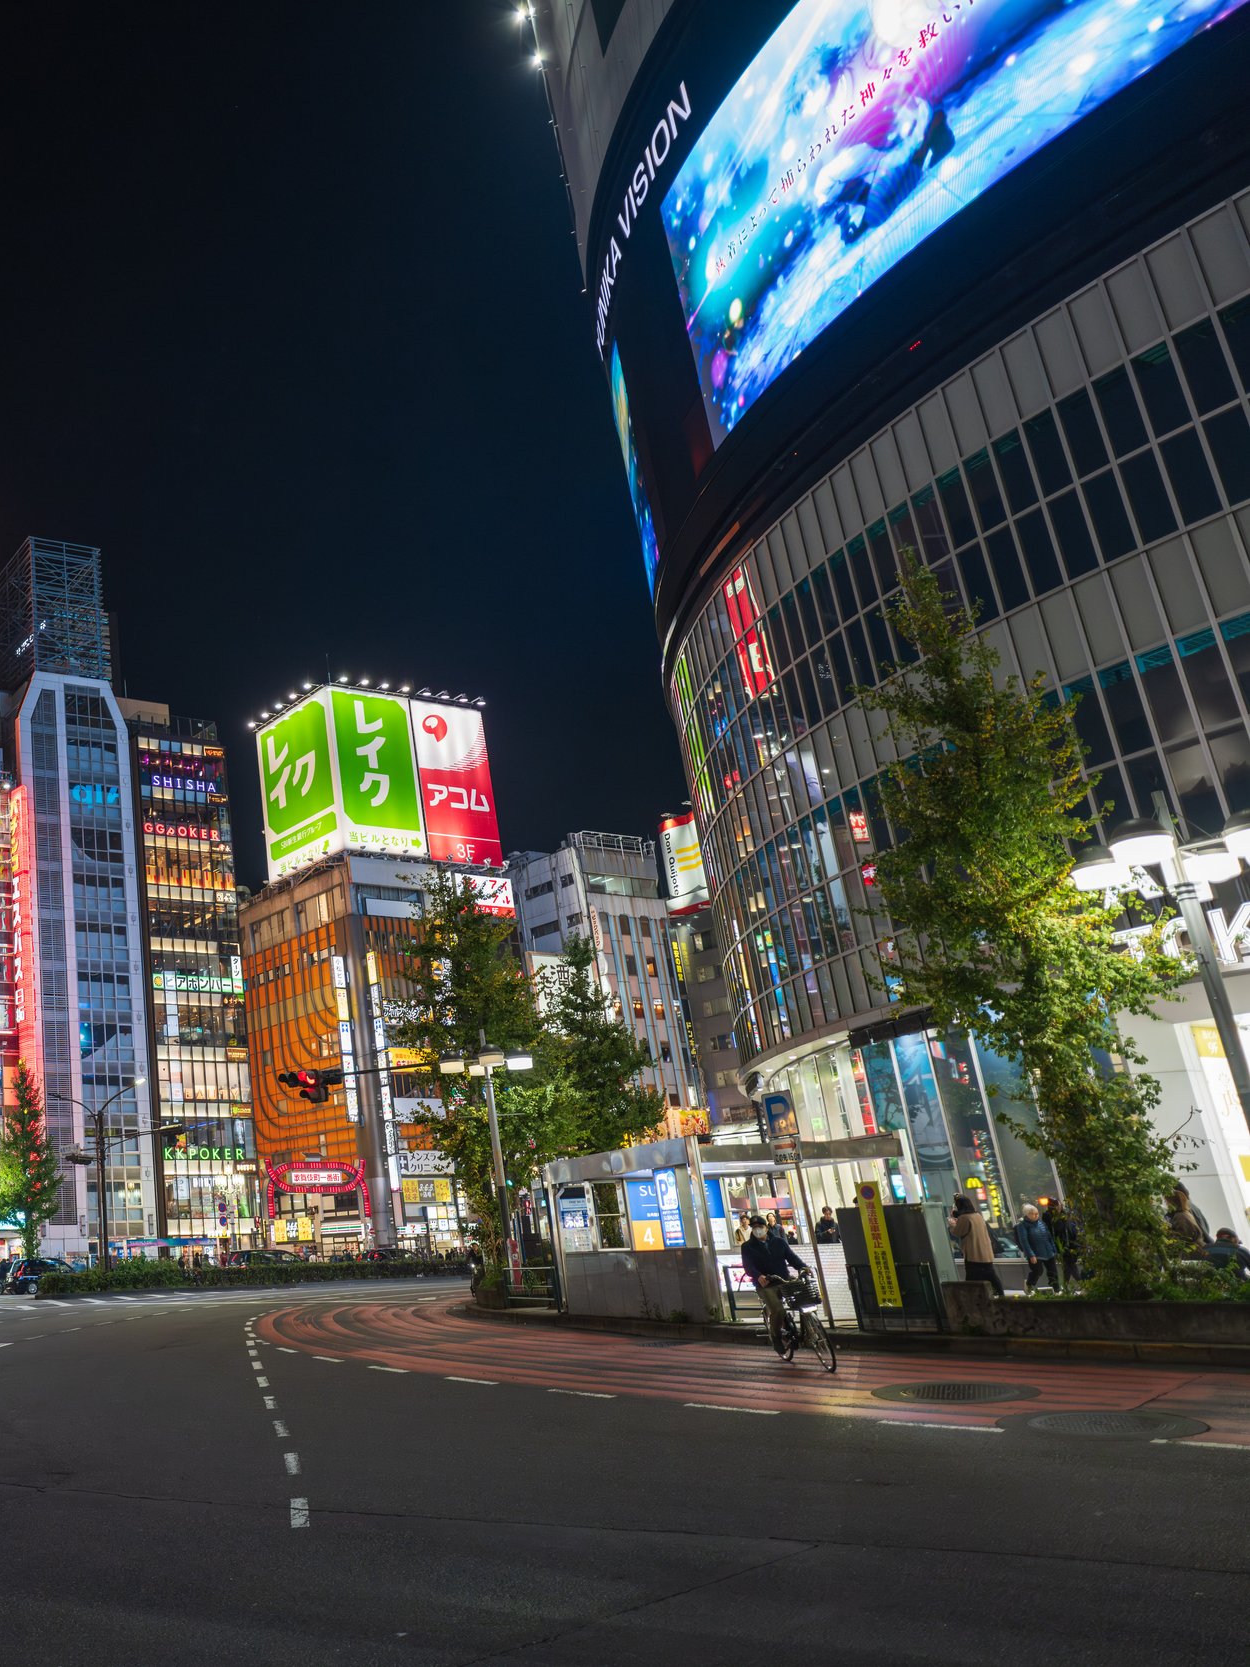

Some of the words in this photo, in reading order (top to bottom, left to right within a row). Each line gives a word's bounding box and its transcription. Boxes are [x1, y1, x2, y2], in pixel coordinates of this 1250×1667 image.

[617, 80, 692, 239] VISION
[353, 700, 390, 807] レイク
[267, 735, 316, 810] レイク
[153, 775, 217, 793] SHISHA
[427, 783, 490, 813] アコム
[143, 822, 221, 842] GGPOKER
[349, 831, 409, 848] 当ビルとなり
[457, 844, 475, 859] 3F
[664, 832, 672, 854] Don
[668, 856, 680, 896] Quijote
[164, 1147, 244, 1160] KKPOKER
[293, 1173, 340, 1182] 歌舞伎町一番街
[866, 1201, 884, 1249] 違法駐車禁止
[643, 1228, 655, 1245] 4
